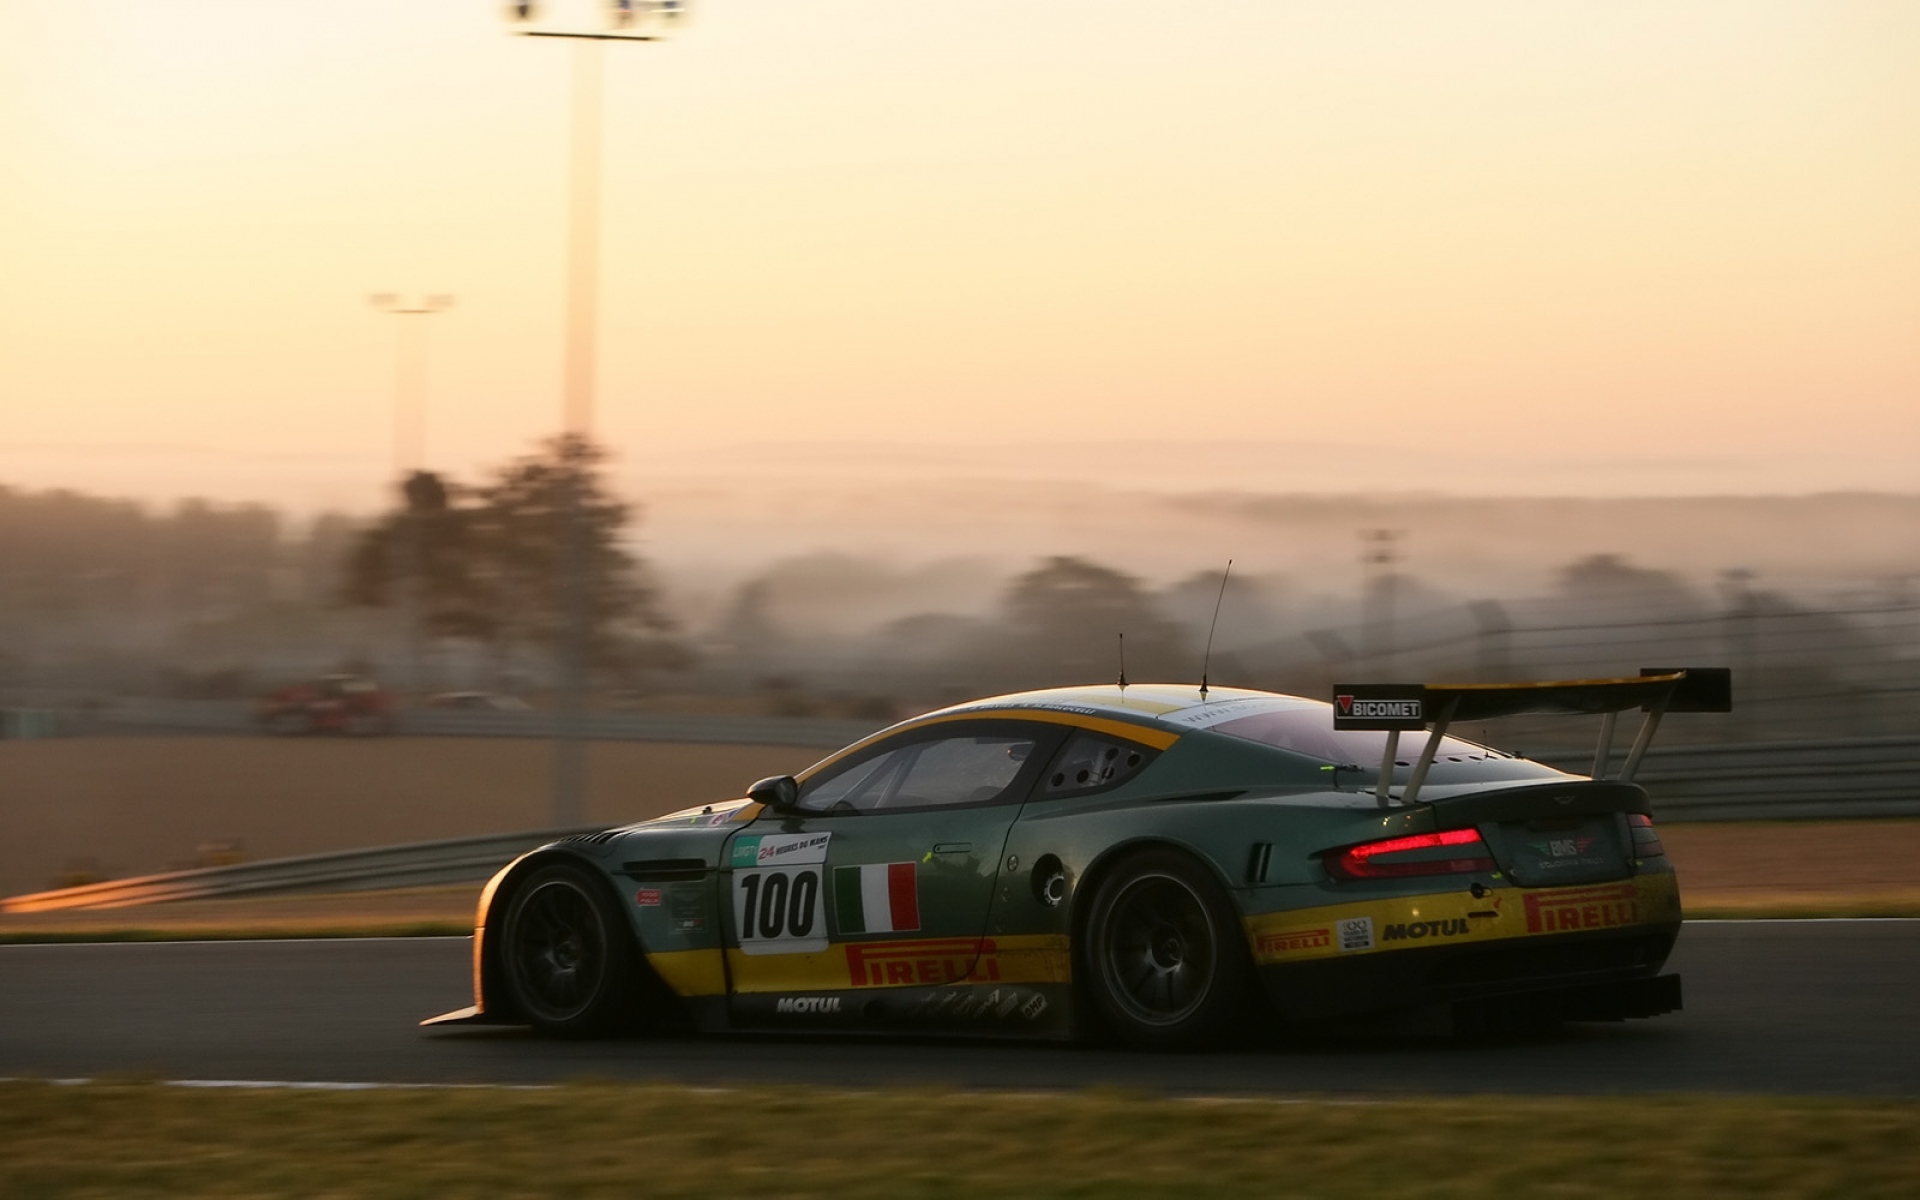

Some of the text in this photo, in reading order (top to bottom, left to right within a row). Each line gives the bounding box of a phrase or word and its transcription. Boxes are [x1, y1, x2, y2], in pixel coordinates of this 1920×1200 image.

[1351, 701, 1420, 717] BICOMET
[759, 846, 775, 860] 24
[776, 842, 799, 856] HEURES
[799, 840, 809, 849] DU
[809, 835, 828, 847] MANS
[741, 870, 818, 939] 100
[1523, 884, 1639, 934] PIRELLI
[1257, 929, 1331, 953] PIRELLI
[1382, 918, 1471, 941] MOTUL
[846, 939, 1000, 986] PIRELLI
[776, 996, 842, 1014] MOTUL
